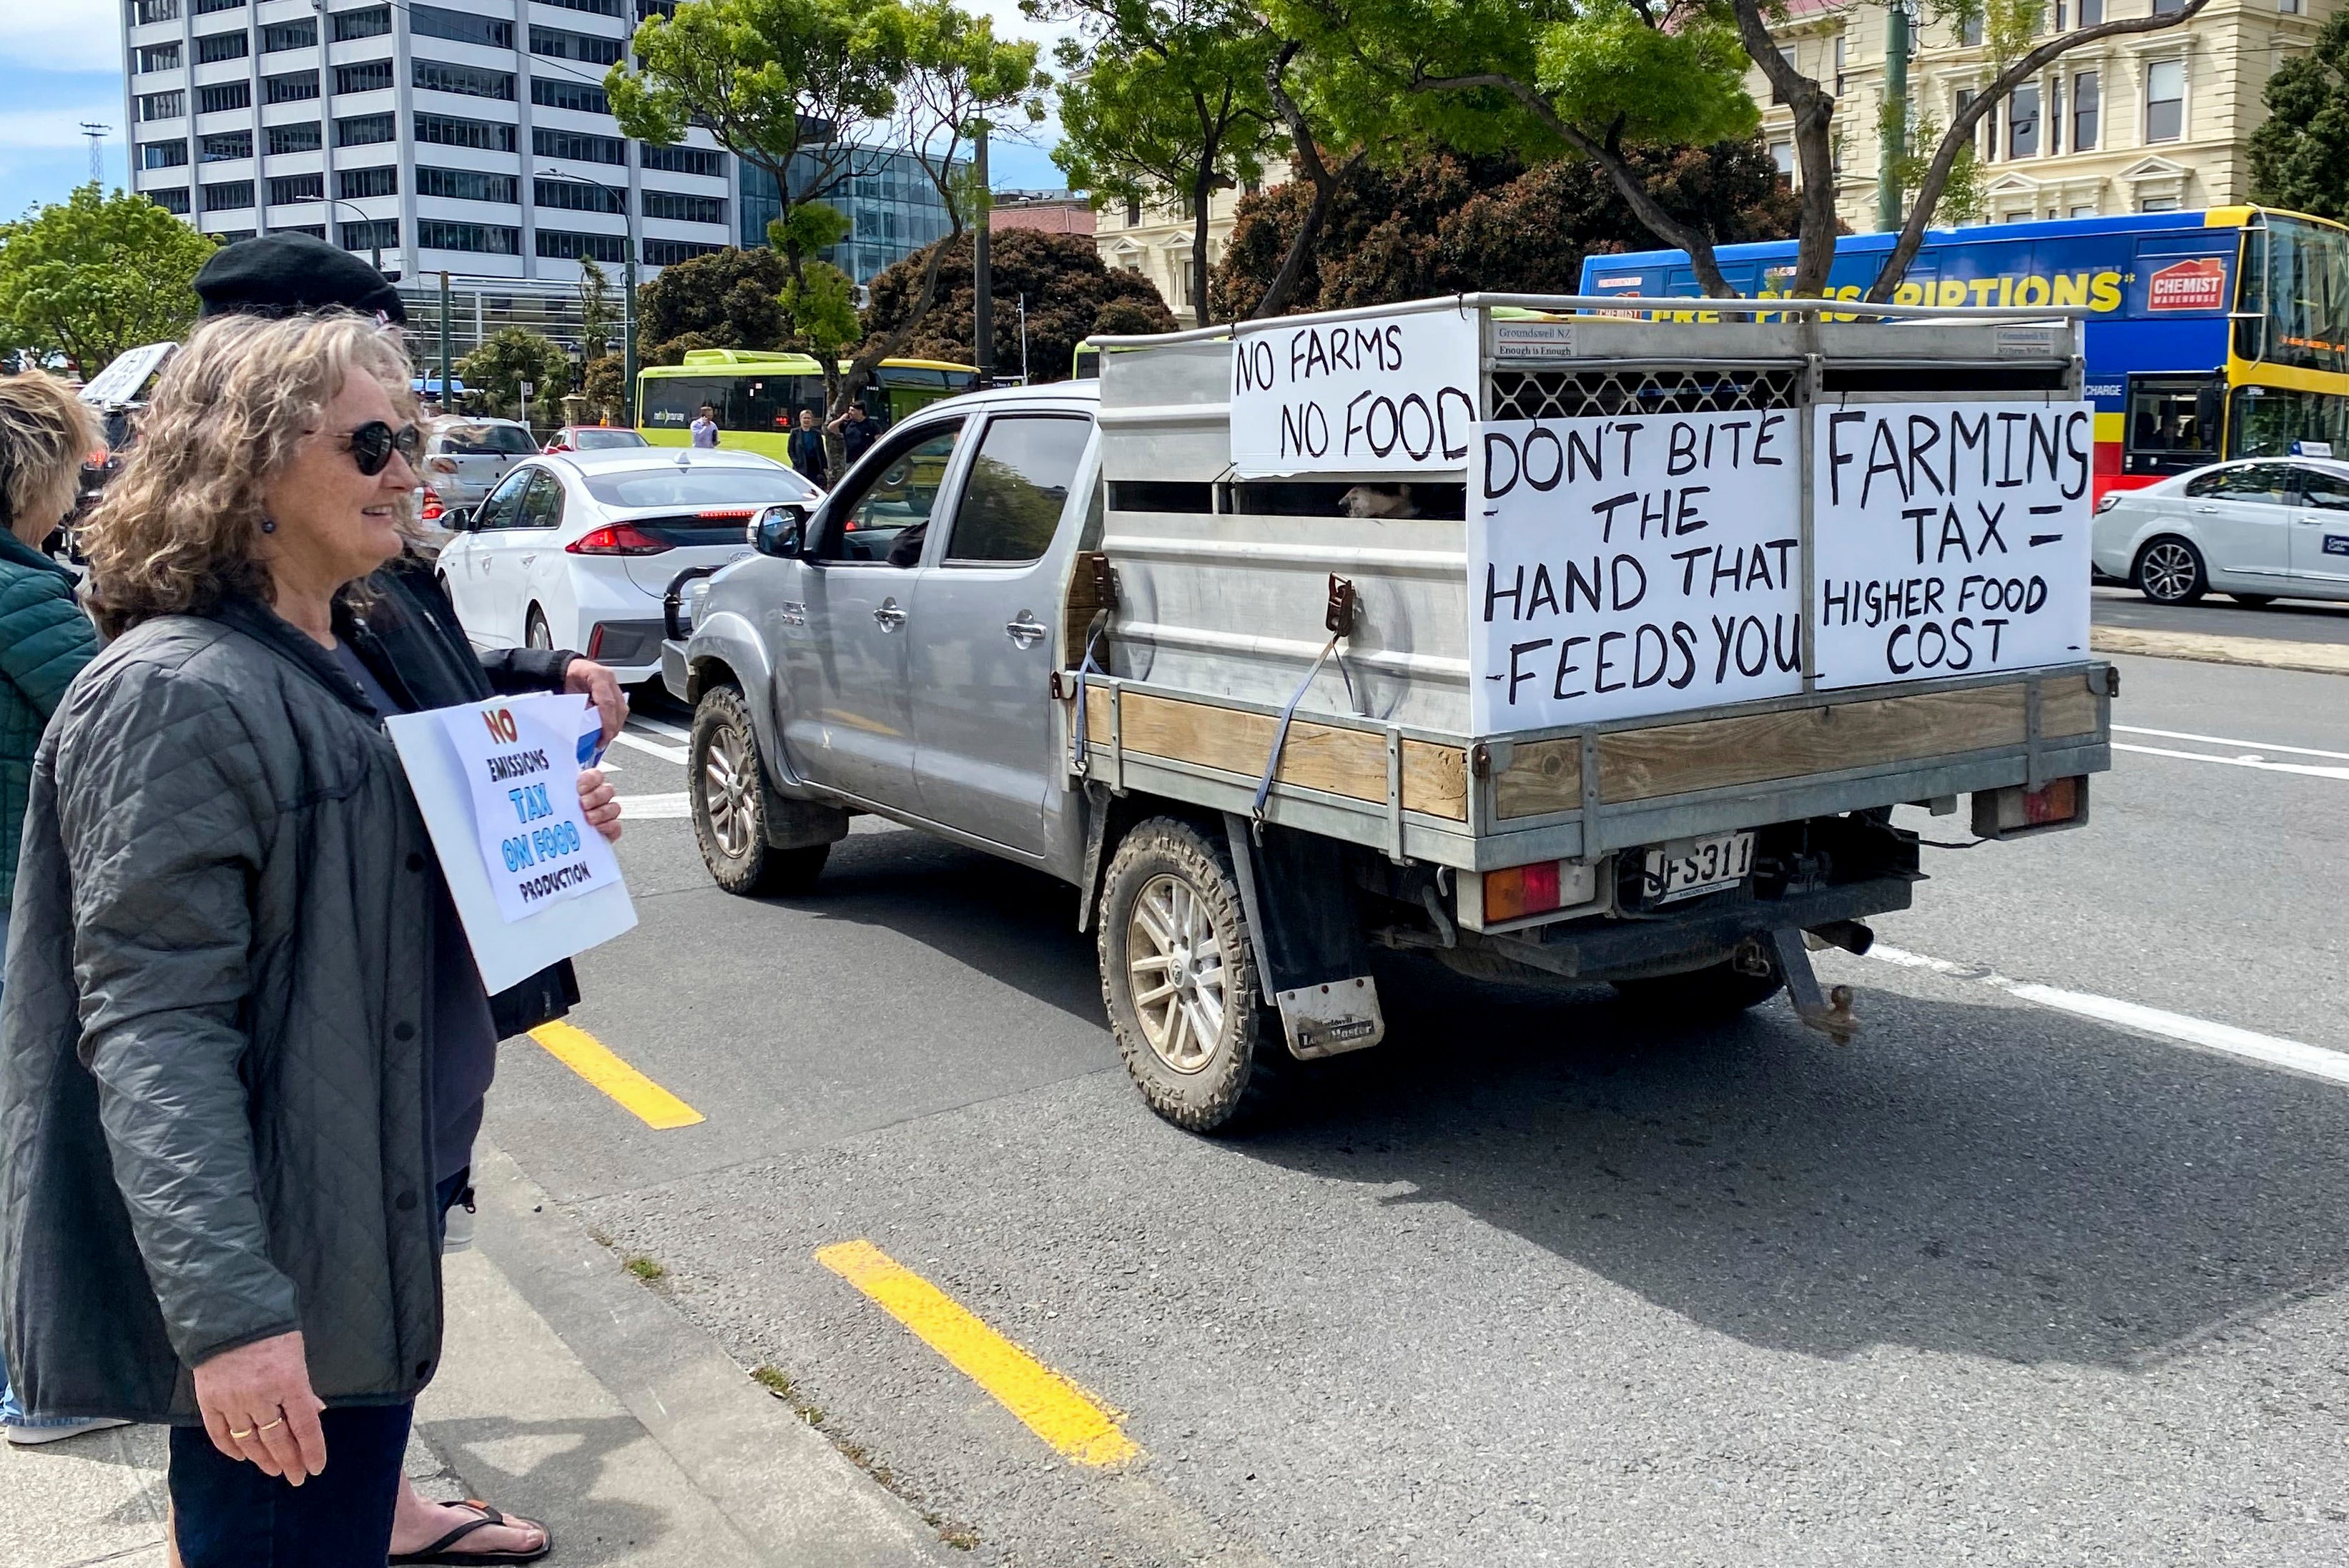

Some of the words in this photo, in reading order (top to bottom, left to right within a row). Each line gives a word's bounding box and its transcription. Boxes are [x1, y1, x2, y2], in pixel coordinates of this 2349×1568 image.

[2153, 294, 2216, 304] WAREHOUSE
[2154, 277, 2221, 295] CHEMIST
[1236, 340, 1274, 395] NO
[1291, 324, 1403, 383] FARMS
[1499, 327, 1555, 338] Groundswell
[1557, 328, 1572, 339] NZ
[1499, 345, 1531, 355] Enough
[1540, 346, 1571, 356] Enough
[1281, 400, 1328, 460] NO
[1344, 386, 1476, 461] FOOD
[1483, 420, 1645, 499] DON'T
[1666, 415, 1786, 476] BITE
[1591, 486, 1710, 543] THE
[1901, 500, 2008, 565] TAX
[2029, 505, 2064, 547] =
[1483, 553, 1647, 622] HAND
[1670, 538, 1798, 598] THAT
[1823, 576, 1945, 628] HIGHER
[1958, 574, 2048, 614] FOOD
[1509, 621, 1698, 705] FEEDS
[1711, 613, 1801, 685] YOU
[1886, 616, 2009, 675] COST
[481, 708, 518, 745] NO
[486, 749, 550, 783] EMISSIONS
[508, 782, 553, 824] TAX
[501, 834, 535, 873] ON
[532, 820, 581, 863] FOOD
[518, 860, 592, 904] PRODUCTION
